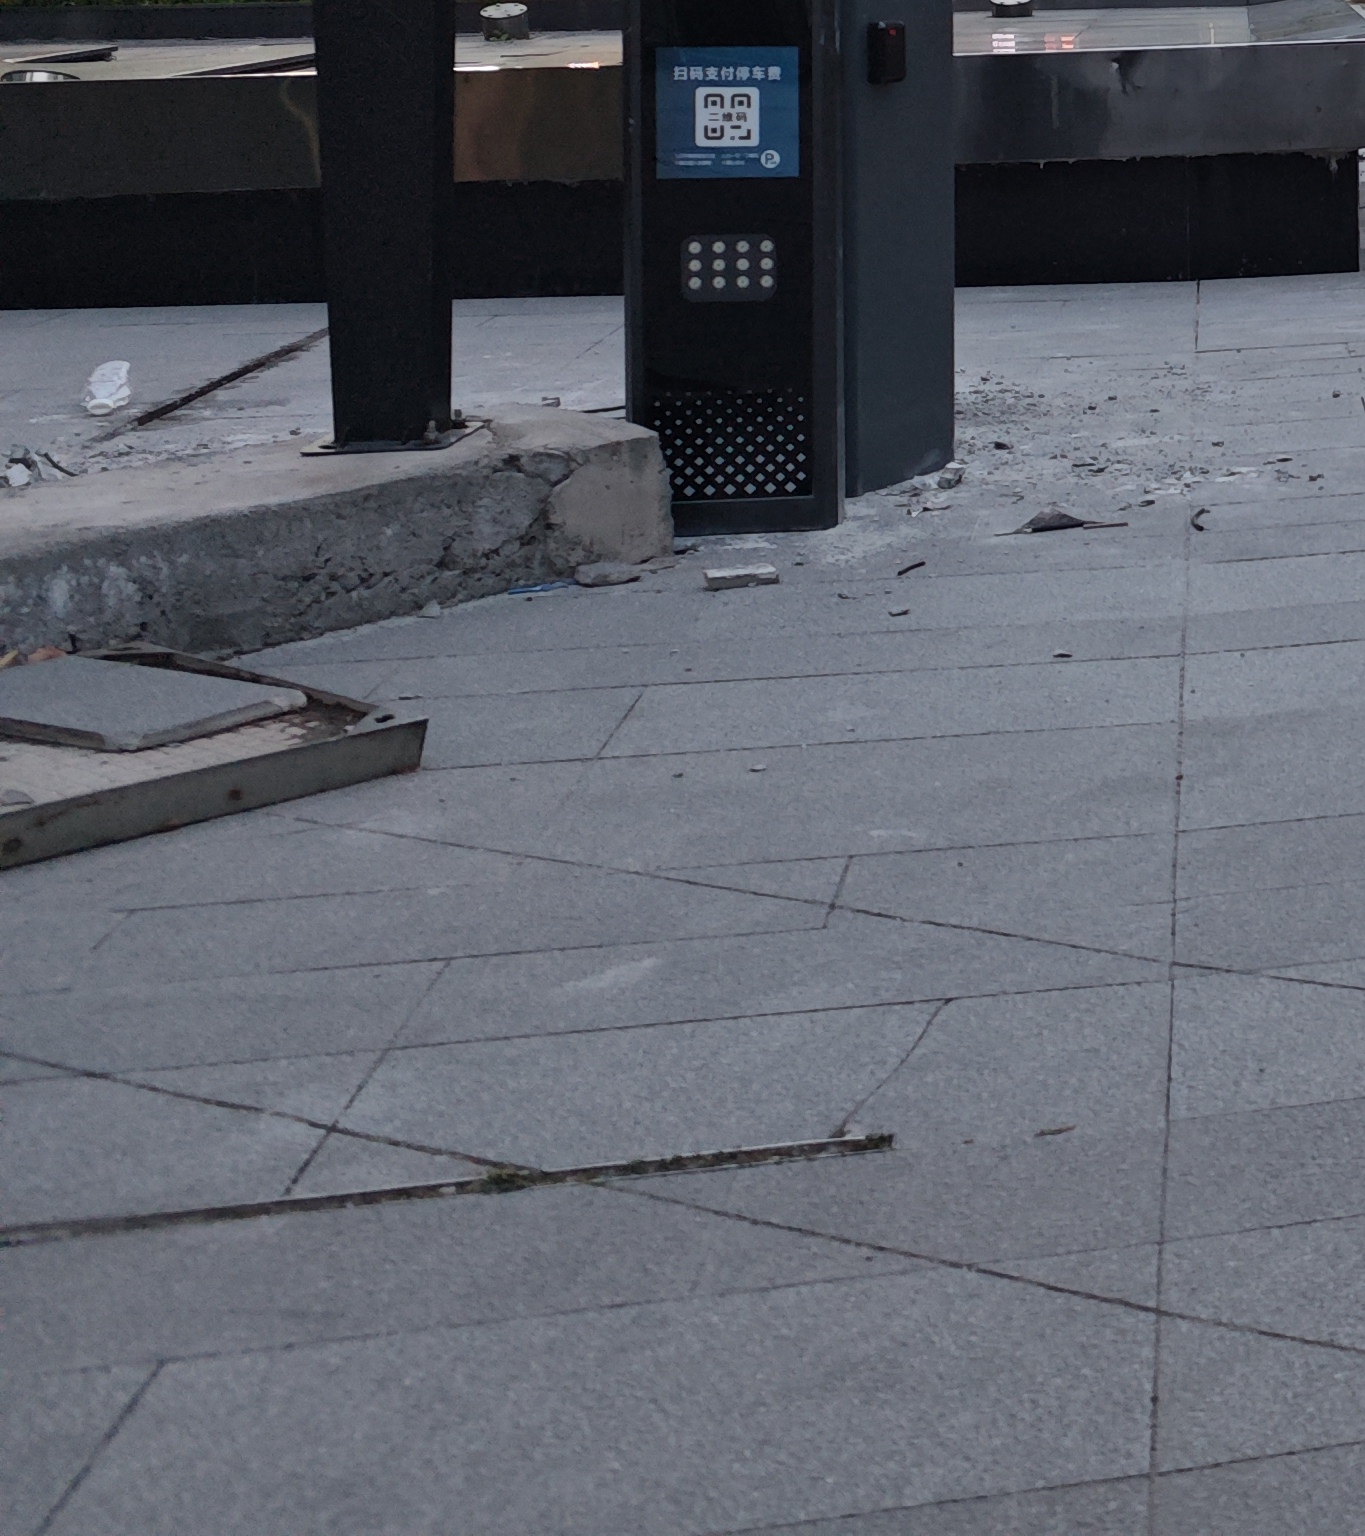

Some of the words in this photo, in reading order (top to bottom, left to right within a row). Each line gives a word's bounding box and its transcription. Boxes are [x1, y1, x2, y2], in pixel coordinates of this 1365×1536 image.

[673, 66, 782, 81] 扫码支付停车费
[708, 112, 748, 123] 二维码
